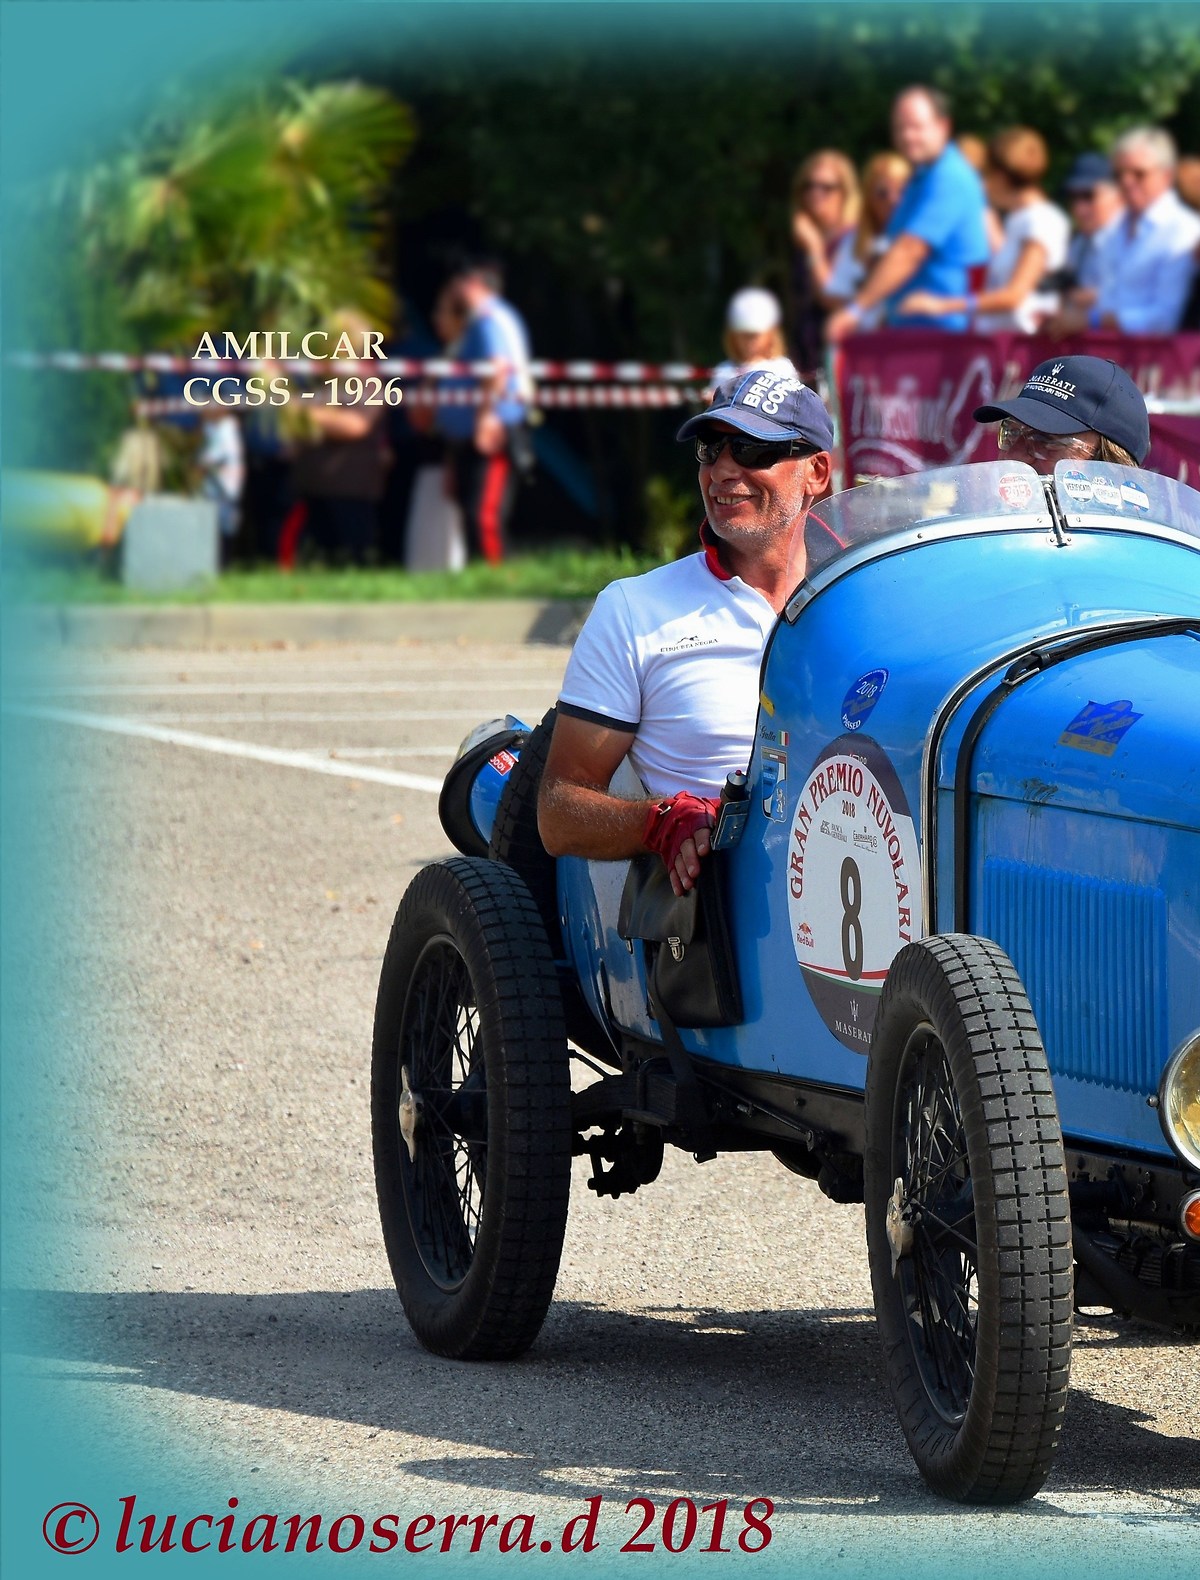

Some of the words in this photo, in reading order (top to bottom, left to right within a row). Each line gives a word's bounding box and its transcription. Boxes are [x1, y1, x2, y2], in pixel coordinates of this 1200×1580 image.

[1028, 375, 1077, 392] MASERATI
[856, 681, 878, 698] 2018
[842, 799, 856, 818] 2018
[790, 801, 813, 900] GRAN
[809, 762, 864, 813] PREMIO
[866, 782, 912, 943] NUVOLARI
[839, 855, 864, 982] 8
[835, 1020, 873, 1044] MASERAT
